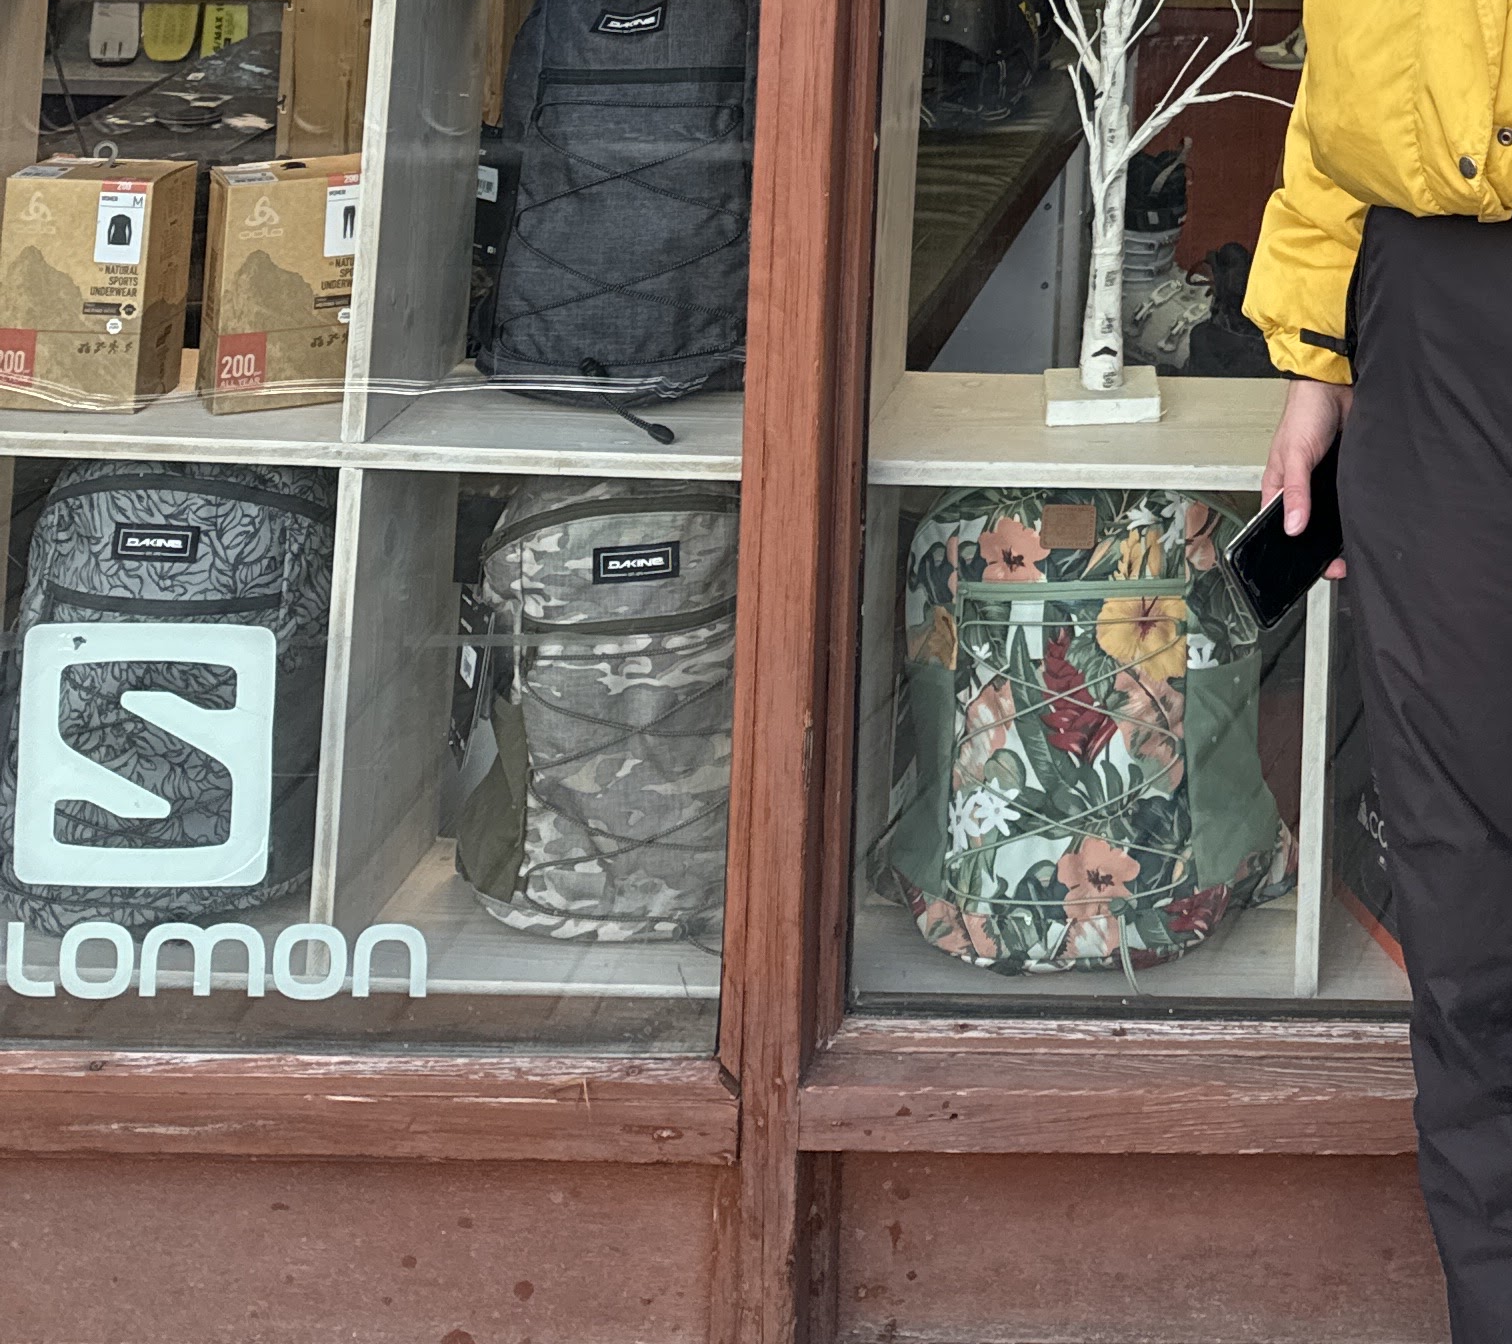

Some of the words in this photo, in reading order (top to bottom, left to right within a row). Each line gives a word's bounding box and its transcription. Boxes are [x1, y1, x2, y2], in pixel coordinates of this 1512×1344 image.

[132, 195, 144, 208] M
[238, 226, 284, 241] odlo
[104, 265, 139, 275] NATURAL
[335, 258, 355, 269] NATU
[321, 278, 354, 291] UNDERW
[89, 286, 138, 298] UNDERWEAR
[220, 353, 255, 379] 200
[125, 537, 183, 549] DAKINE
[607, 556, 665, 570] DAKINE
[6, 921, 428, 1000] lomon
